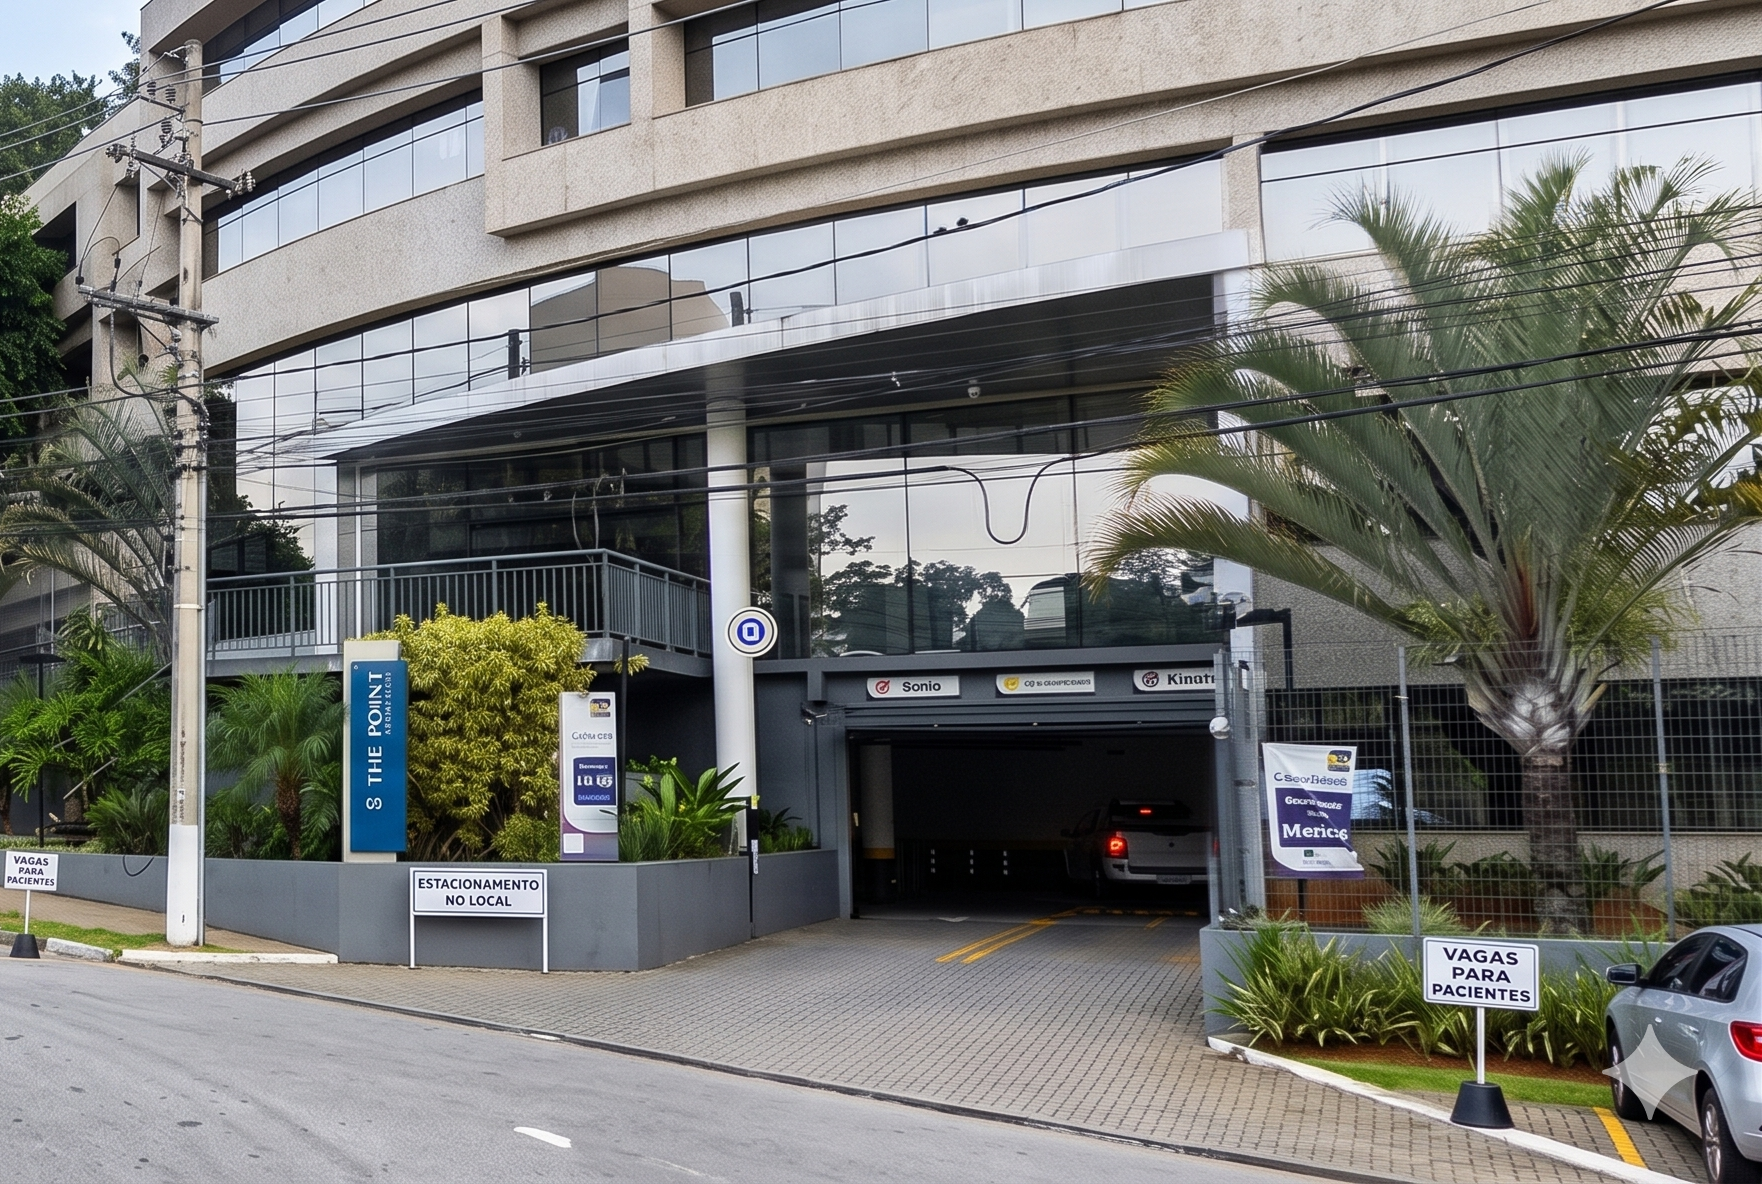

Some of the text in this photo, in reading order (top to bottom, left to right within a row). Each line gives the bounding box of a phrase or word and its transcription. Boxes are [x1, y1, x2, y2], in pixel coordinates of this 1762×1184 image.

[902, 681, 942, 693] Sonio
[367, 746, 383, 787] THE
[13, 855, 49, 866] VAGAS
[18, 866, 44, 876] PARA
[7, 875, 55, 887] PACIENTES
[418, 878, 540, 891] ESTACIONAMENTO
[445, 895, 512, 907] NO LOCAL
[1442, 946, 1519, 966] VAGAS
[1452, 966, 1512, 984] PARA
[1432, 983, 1531, 1003] PACIENTES
